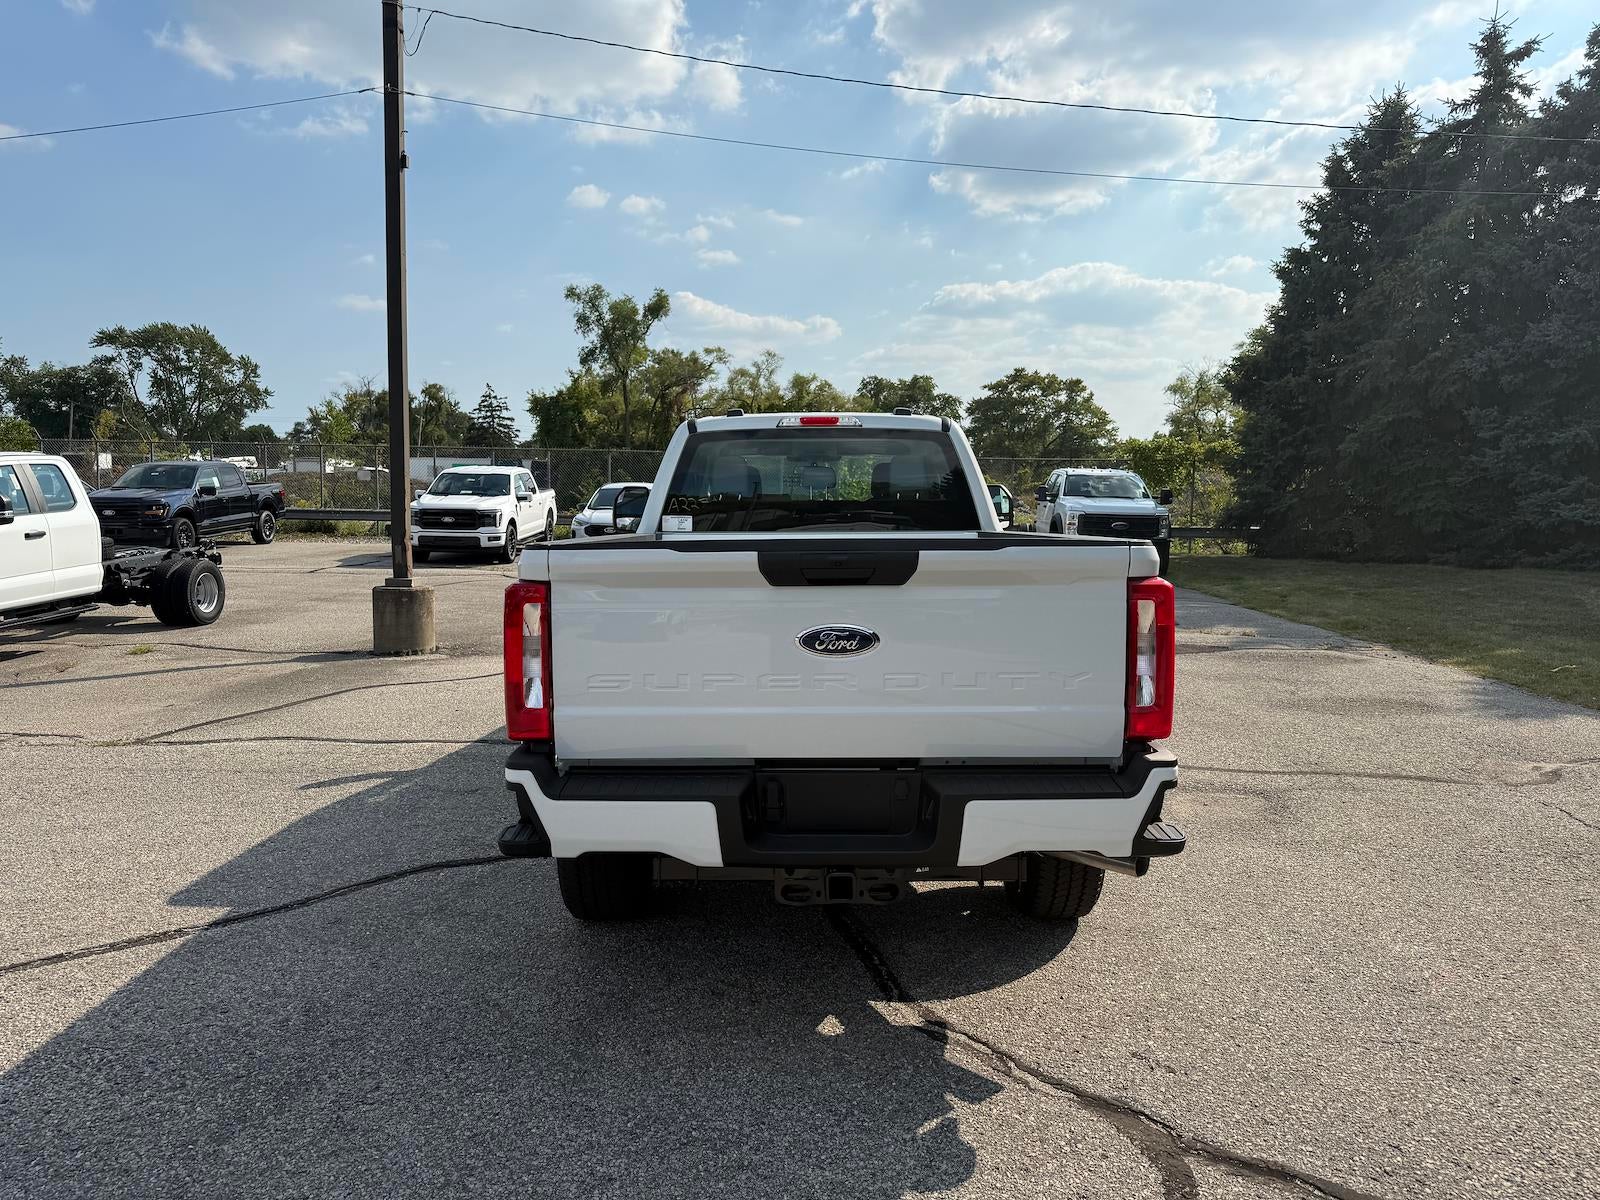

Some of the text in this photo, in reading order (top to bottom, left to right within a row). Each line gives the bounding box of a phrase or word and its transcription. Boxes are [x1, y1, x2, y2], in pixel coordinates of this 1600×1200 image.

[815, 631, 860, 650] Ford
[587, 671, 1092, 692] SUPER DUTY
